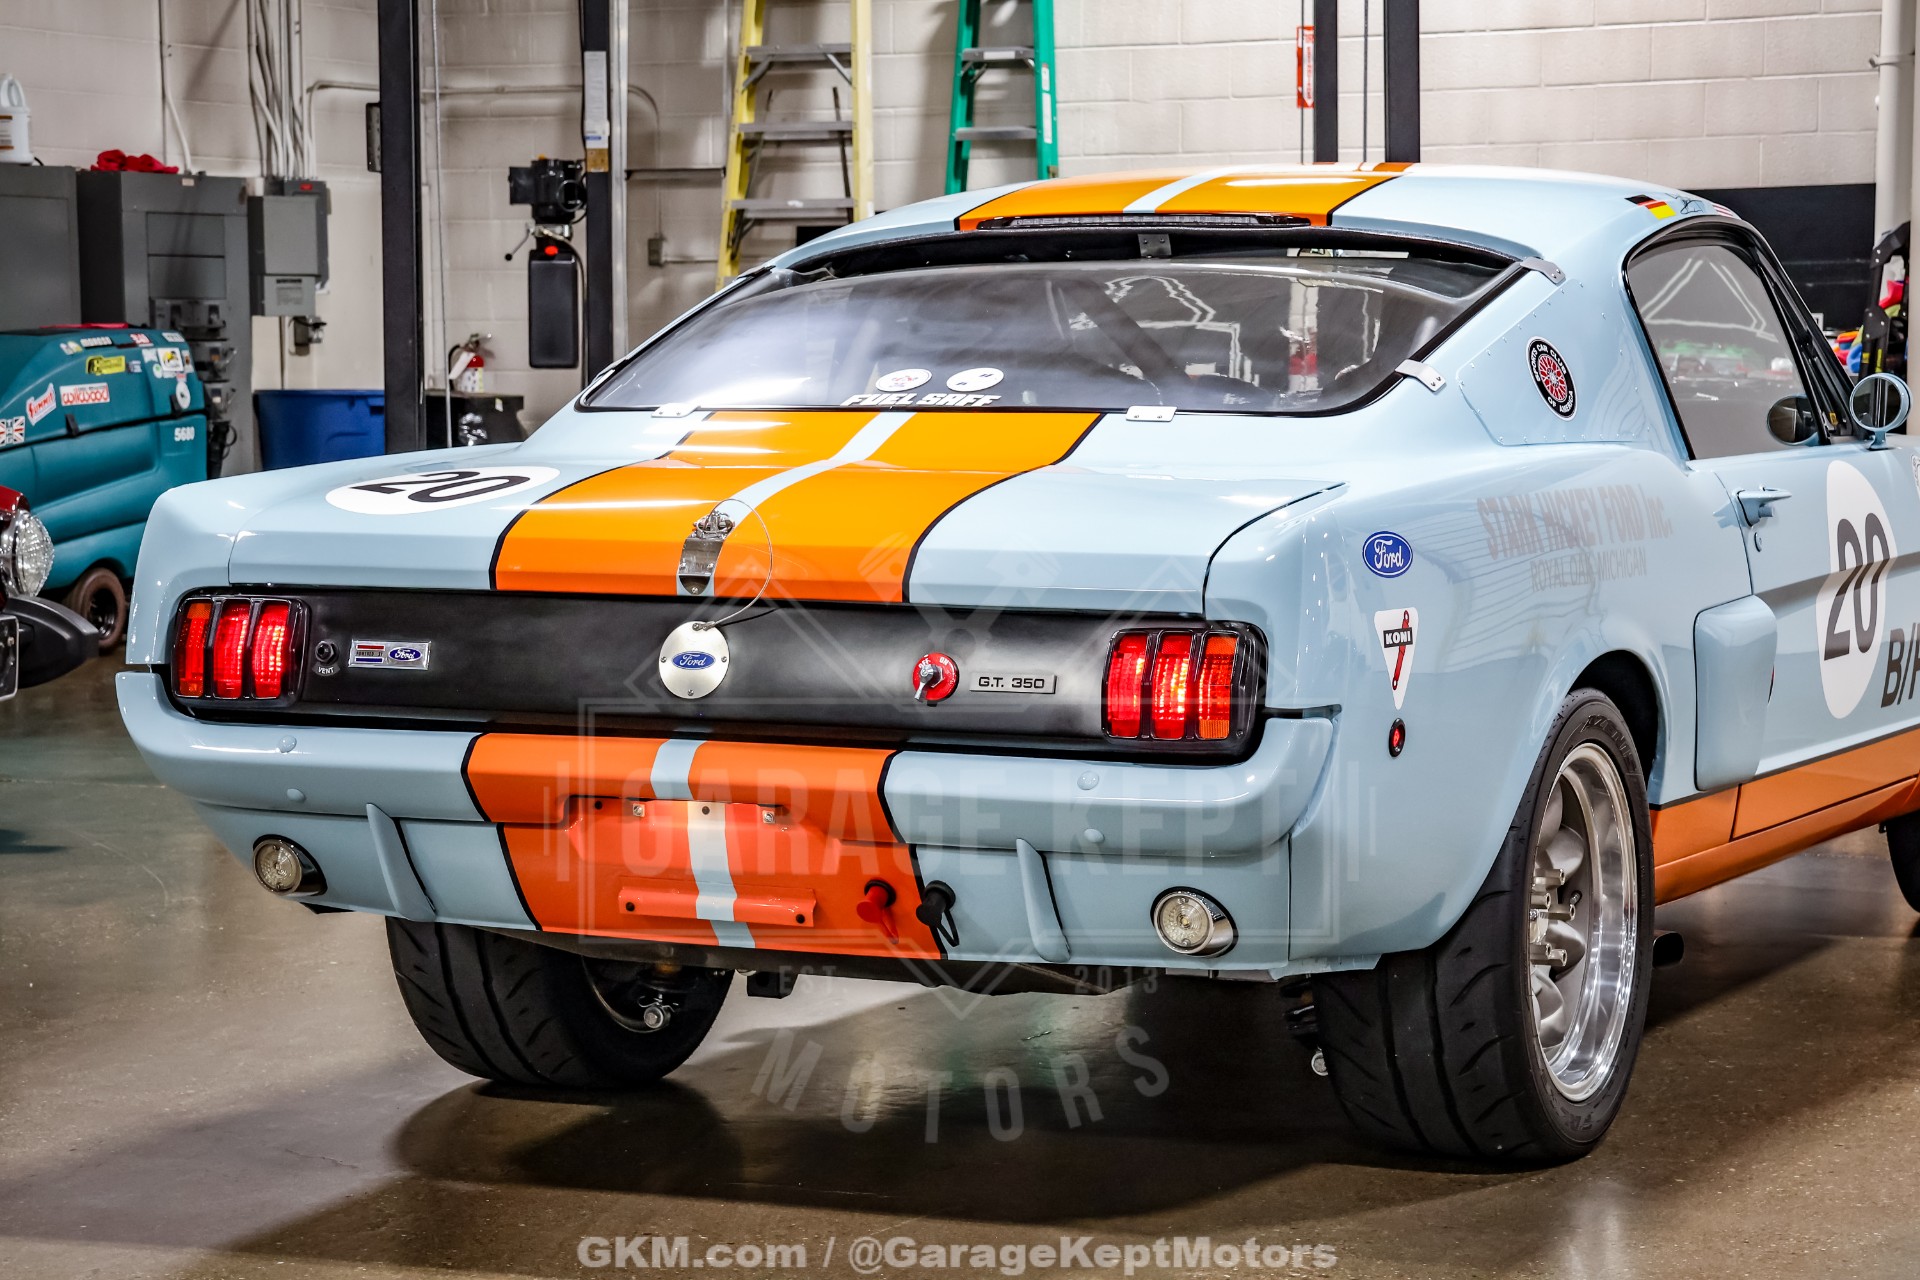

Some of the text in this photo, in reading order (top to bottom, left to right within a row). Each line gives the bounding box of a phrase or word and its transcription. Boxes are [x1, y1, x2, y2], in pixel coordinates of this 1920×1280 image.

[1536, 344, 1549, 353] CAR
[1550, 349, 1567, 374] CLUB
[62, 385, 109, 405] wilwood
[839, 393, 917, 406] FUEL
[1547, 396, 1557, 407] OF
[349, 471, 531, 503] 20
[1476, 494, 1545, 560] STARK
[1597, 484, 1646, 545] FORD
[1530, 557, 1568, 593] ROYAL
[1597, 546, 1648, 582] MICHIGAN
[1824, 513, 1890, 661] 20
[1385, 630, 1411, 645] KONI
[939, 656, 950, 666] ON
[318, 666, 334, 674] VENT
[978, 676, 1045, 689] G.T. 350
